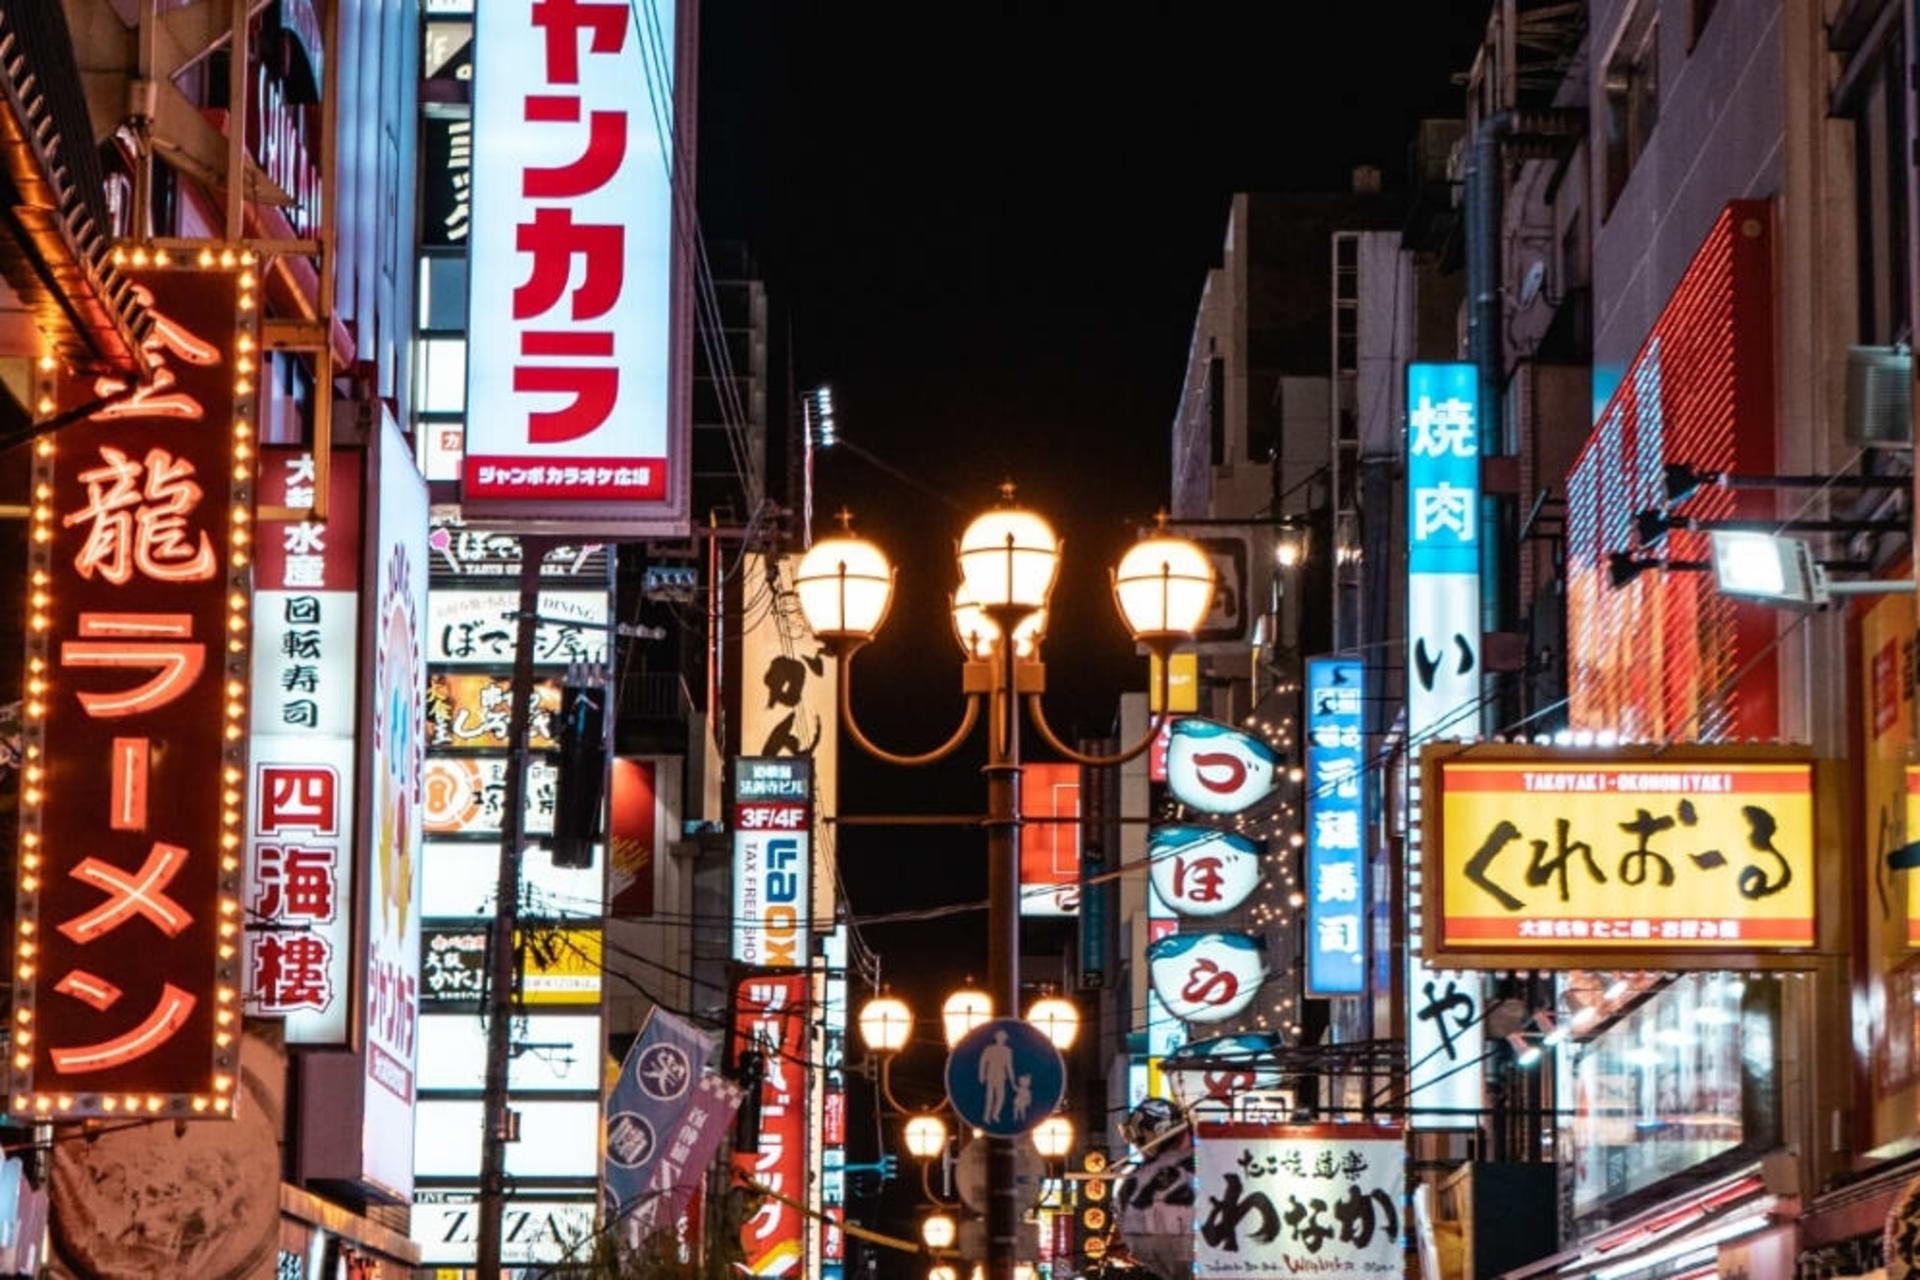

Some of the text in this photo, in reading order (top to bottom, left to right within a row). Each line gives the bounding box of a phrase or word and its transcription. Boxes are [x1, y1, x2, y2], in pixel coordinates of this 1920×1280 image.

[478, 466, 651, 486] ジャンボカラオケ広場
[1410, 395, 1478, 541] 焼肉
[279, 595, 322, 729] 回転寿司
[741, 808, 805, 828] 3F/4F
[1464, 798, 1792, 911] くれおーる
[256, 763, 340, 1014] 四海樓
[742, 842, 757, 965] TAX FREE SHO
[443, 1210, 567, 1246] ZZA
[1200, 1172, 1399, 1254] わなか
